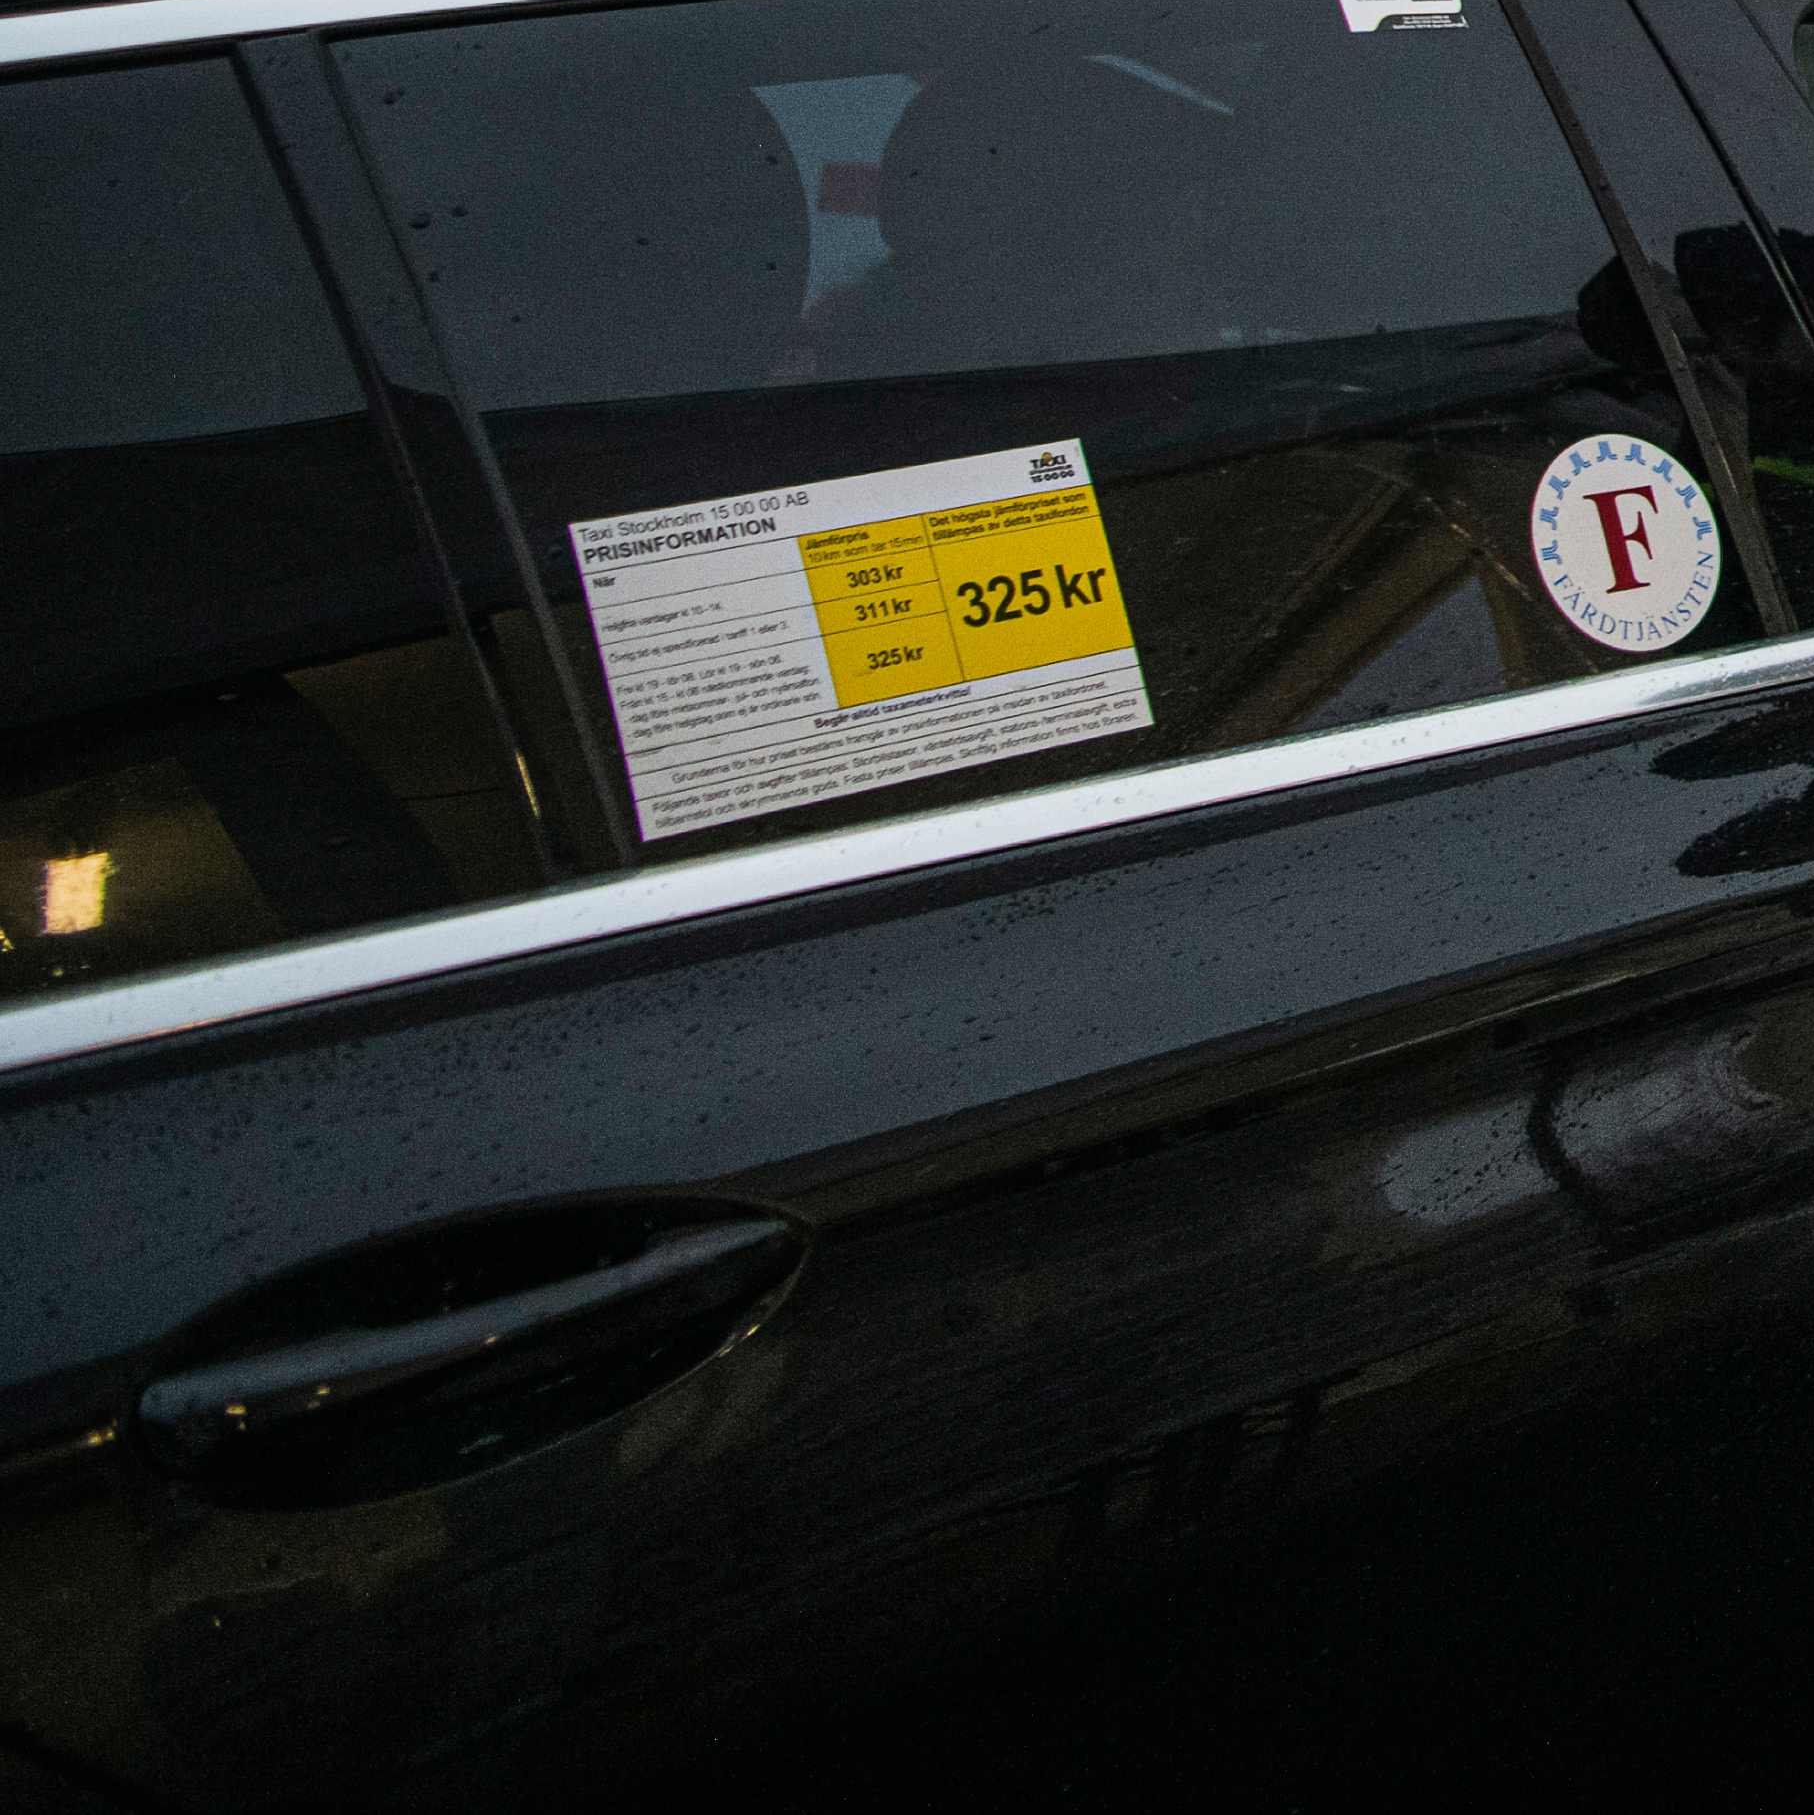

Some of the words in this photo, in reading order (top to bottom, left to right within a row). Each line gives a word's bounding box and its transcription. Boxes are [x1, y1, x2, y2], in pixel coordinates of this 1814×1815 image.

[577, 527, 613, 542] Taxi
[617, 511, 704, 536] Stockholm
[710, 504, 729, 519] 15
[733, 500, 755, 516] 00
[758, 495, 780, 512] 00
[785, 490, 809, 507] AB
[583, 518, 775, 562] PRISINFORMATION
[1582, 484, 1660, 595] F
[846, 567, 882, 588] 303
[882, 564, 903, 581] kr
[957, 569, 1050, 627] 325
[1054, 564, 1105, 608] kr
[1553, 550, 1714, 641] FÄRDTJÄNSTEN
[854, 600, 889, 621] 311
[890, 597, 912, 614] kr
[866, 647, 902, 670] 325
[902, 645, 923, 662] kr
